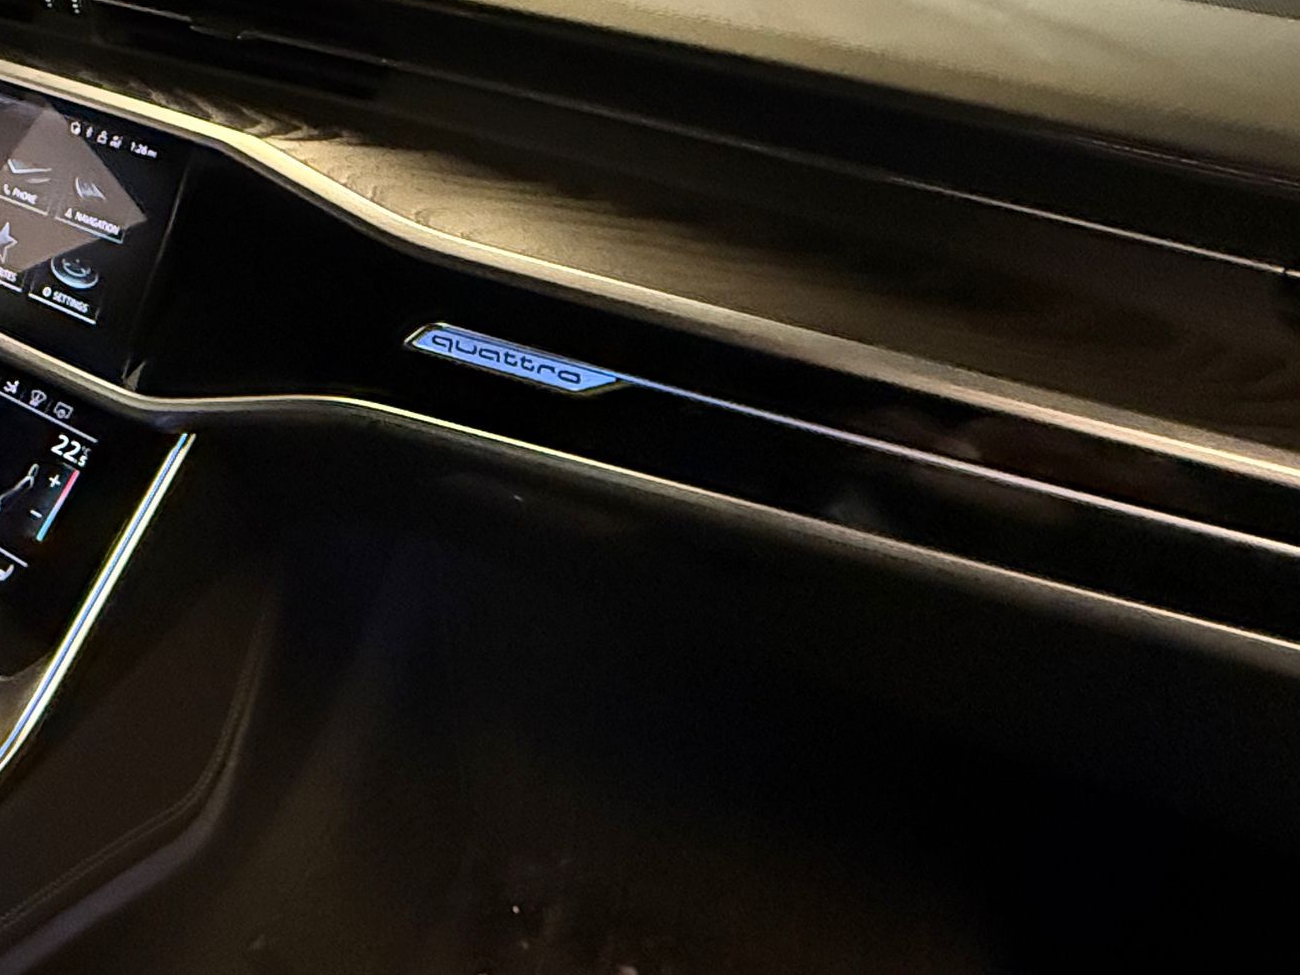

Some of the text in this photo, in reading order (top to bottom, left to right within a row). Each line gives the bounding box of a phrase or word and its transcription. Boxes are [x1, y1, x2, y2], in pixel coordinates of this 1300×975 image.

[74, 211, 120, 235] NAVIGATION
[52, 290, 90, 313] SETTINGS
[431, 333, 582, 385] quattro
